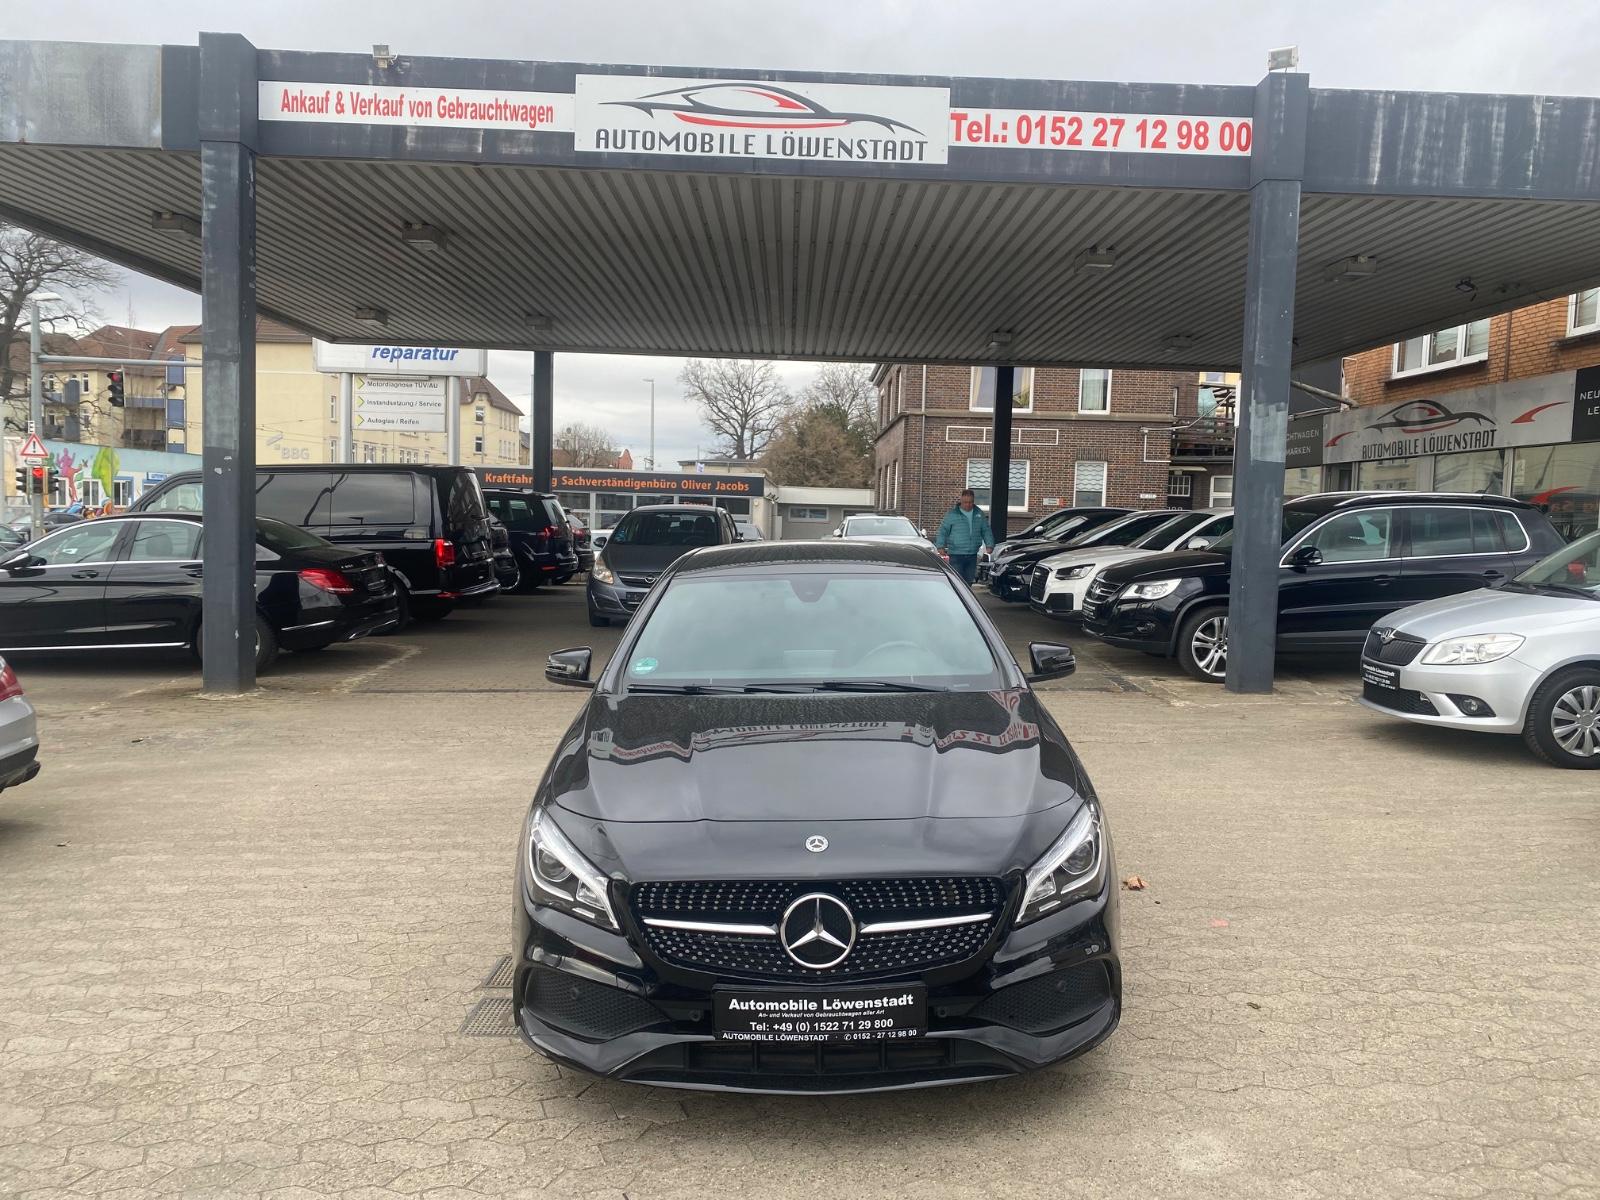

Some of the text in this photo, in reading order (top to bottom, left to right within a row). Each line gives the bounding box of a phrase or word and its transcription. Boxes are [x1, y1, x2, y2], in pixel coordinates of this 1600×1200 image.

[281, 88, 554, 128] Ankauf & Verkauf von Gebrauchtwagen
[950, 113, 1253, 152] Tel.: 0152 27 12 98 00
[595, 128, 928, 161] AUTOMOBILE LÖWENSTADT
[372, 346, 459, 363] reparatur
[367, 381, 413, 389] Motordiagnose
[367, 399, 414, 408] Instandsetzung
[367, 417, 395, 425] Autoglas
[1362, 429, 1497, 460] AUTOMOBILE LÖWENSTADT
[281, 447, 310, 459] BBG
[485, 472, 750, 492] Kraftfahrg Sachverständigenbüro Oliver Jacobs
[728, 994, 914, 1011] Automobile Löwenstadt
[815, 1010, 862, 1018] Gebrauchtwagen
[749, 1018, 894, 1032] Tel: +49 (0) 1522 71 29 800
[722, 1033, 774, 1041] AUTOMOBILE
[775, 1032, 830, 1042] LÖWENSTADT
[853, 1032, 871, 1040] 0152
[876, 1031, 886, 1039] 27
[887, 1030, 896, 1038] 12
[908, 1029, 917, 1037] 00
